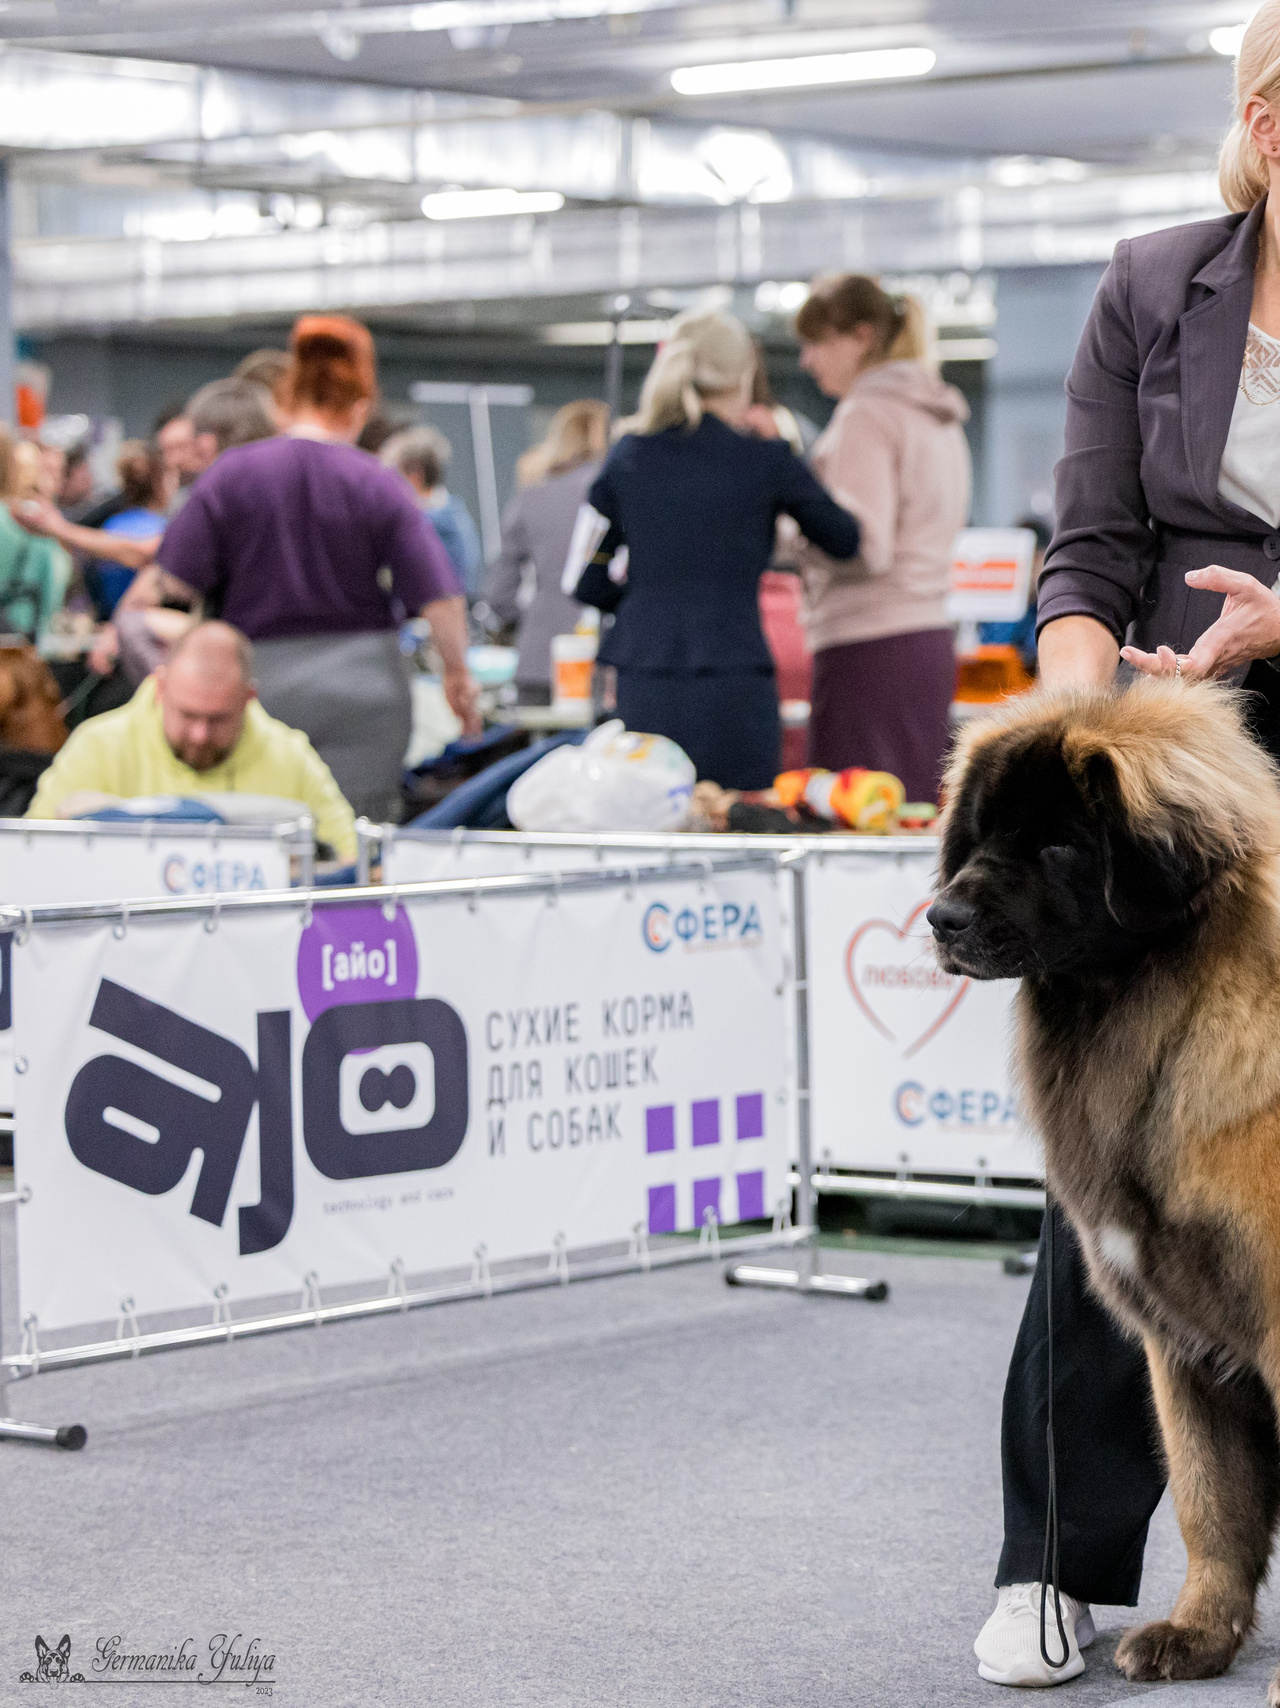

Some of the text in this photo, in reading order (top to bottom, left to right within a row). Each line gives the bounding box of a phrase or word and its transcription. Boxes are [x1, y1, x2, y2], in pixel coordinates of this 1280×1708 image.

[161, 853, 267, 893] СФЕРА
[641, 902, 764, 953] СФЕРА
[485, 991, 695, 1052] СУХИЕ КОРМА
[486, 1045, 659, 1110] ДЛЯ КОШЕК
[488, 1101, 623, 1157] И СОБАК
